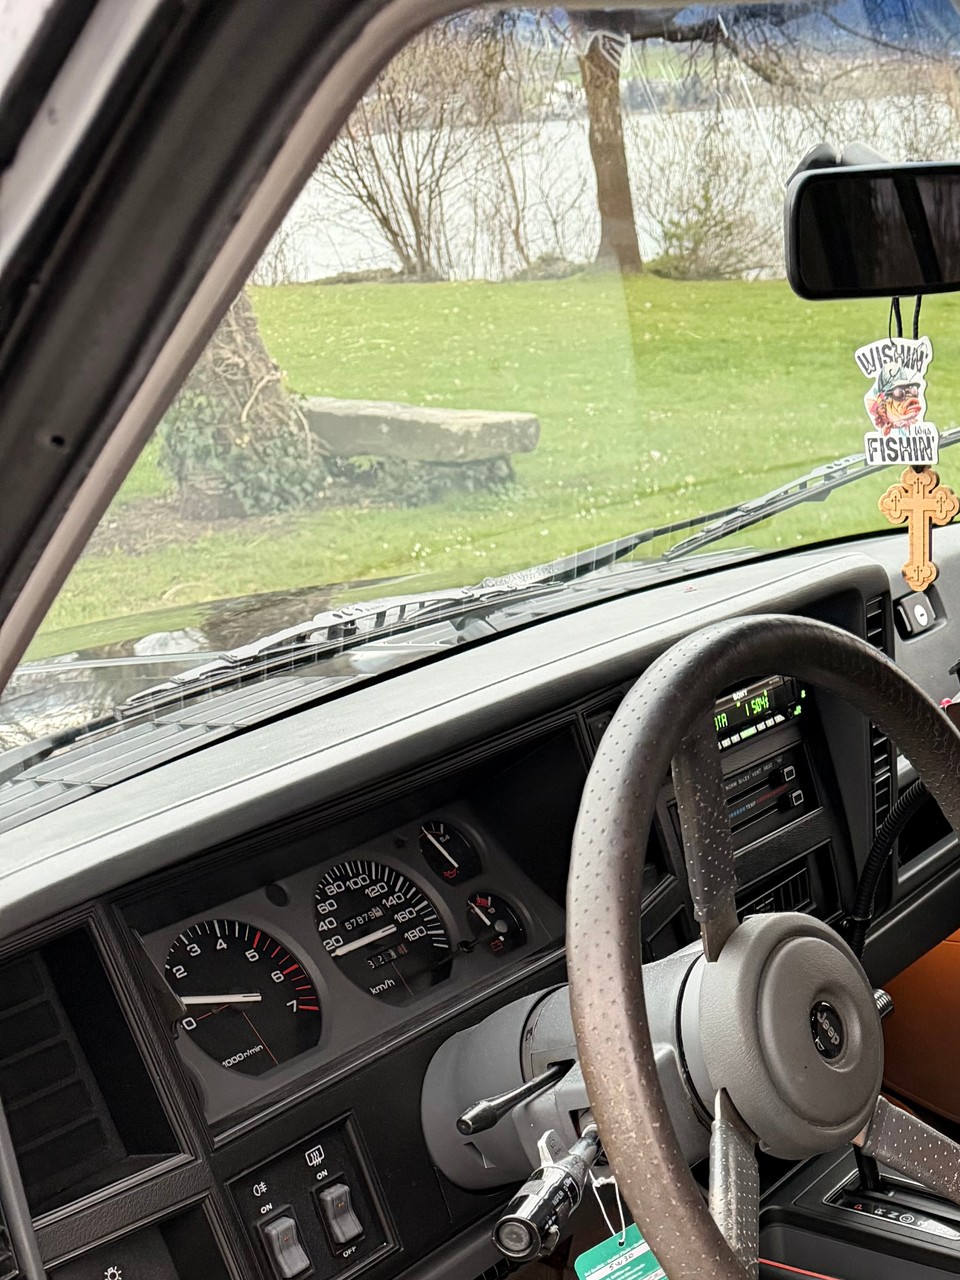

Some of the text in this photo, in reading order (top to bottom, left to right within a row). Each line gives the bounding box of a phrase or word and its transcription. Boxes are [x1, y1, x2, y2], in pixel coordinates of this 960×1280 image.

[857, 343, 929, 375] WISHIN'
[867, 436, 935, 462] FISHIN'
[325, 881, 345, 896] 80
[345, 874, 370, 890] 100
[364, 882, 388, 898] 120
[317, 899, 338, 914] 60
[382, 892, 405, 908] 140
[394, 907, 417, 923] 160
[318, 917, 337, 932] 40
[404, 925, 427, 941] 180
[187, 944, 201, 957] 3
[216, 939, 227, 950] 4
[323, 935, 344, 951] 20
[245, 949, 260, 962] 5
[172, 966, 188, 979] 2
[271, 970, 285, 983] 6
[369, 979, 396, 995] km/h
[286, 1000, 297, 1012] 7
[182, 1017, 197, 1031] 0
[816, 1012, 840, 1045] Jeep
[316, 1169, 328, 1180] ON
[260, 1202, 273, 1214] ON
